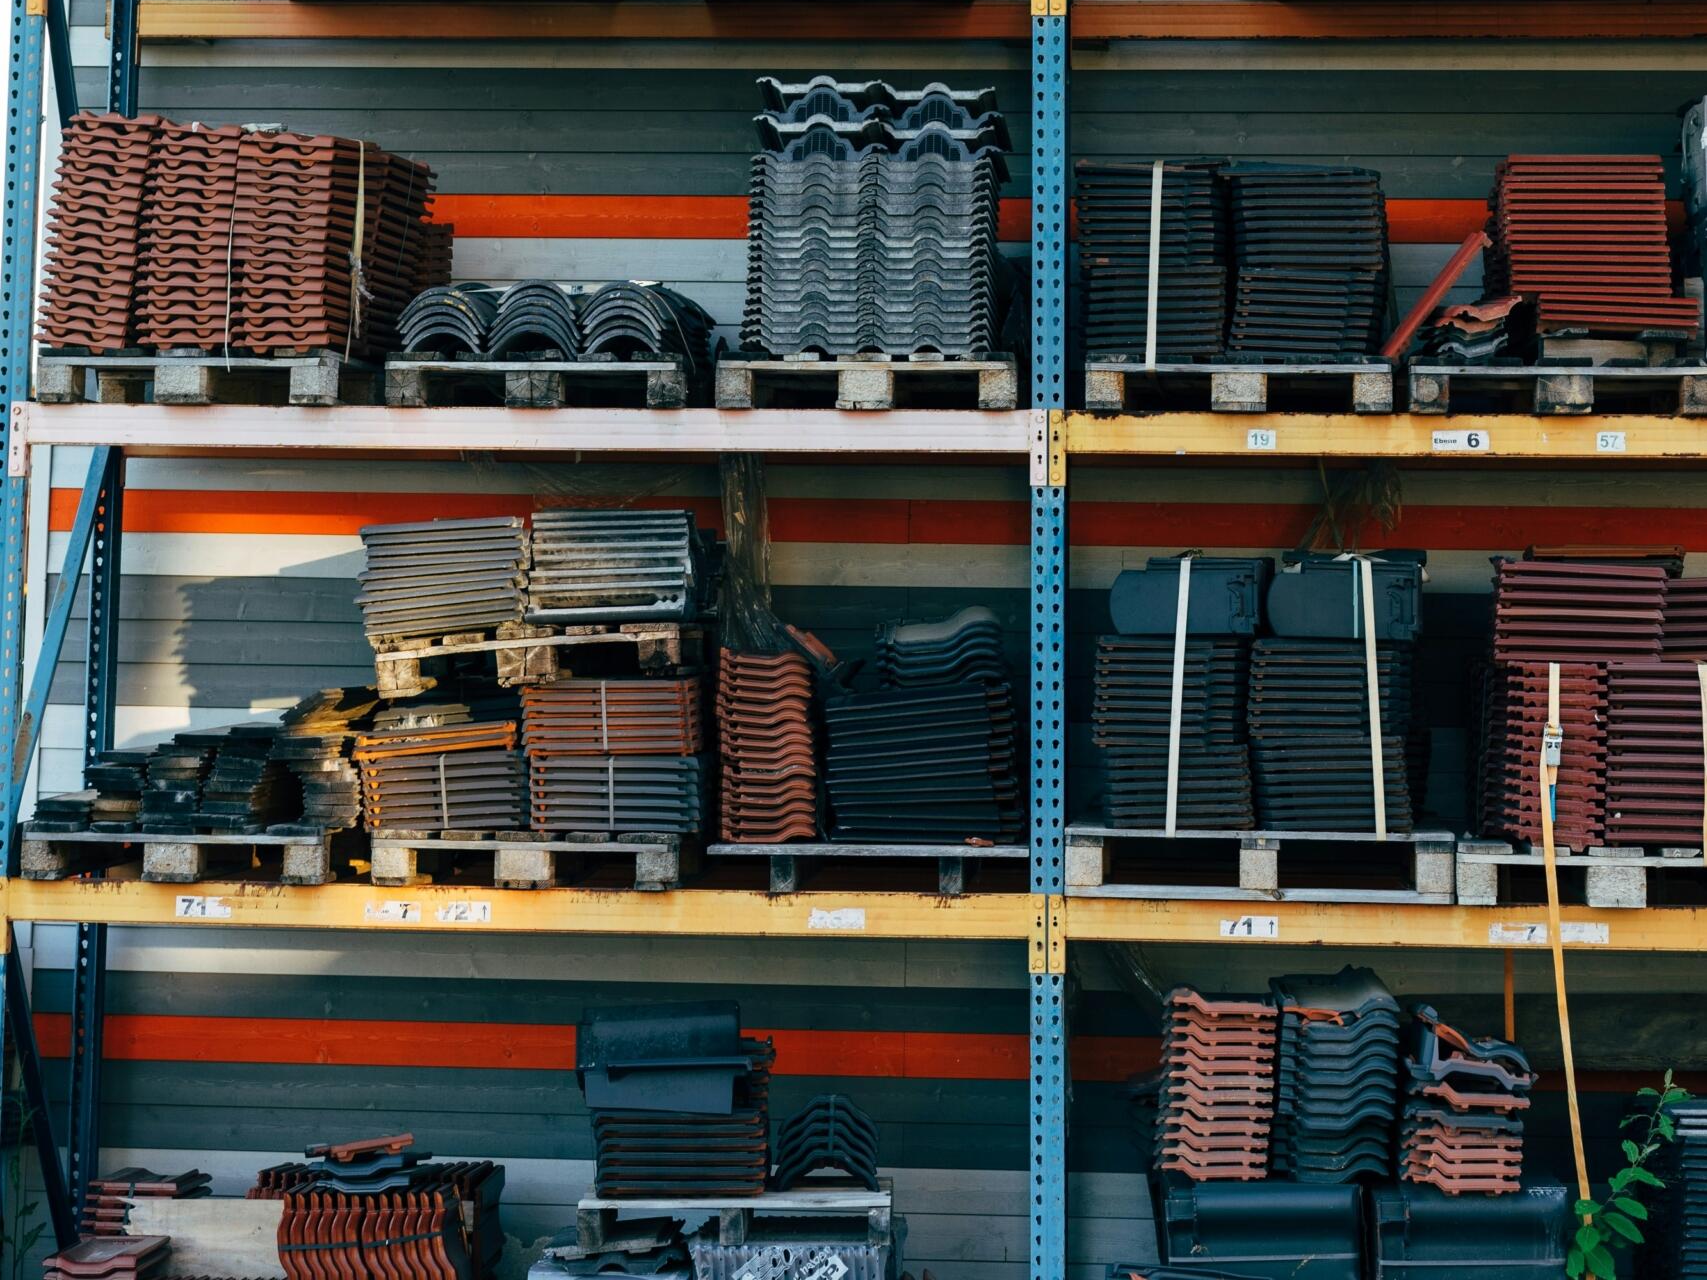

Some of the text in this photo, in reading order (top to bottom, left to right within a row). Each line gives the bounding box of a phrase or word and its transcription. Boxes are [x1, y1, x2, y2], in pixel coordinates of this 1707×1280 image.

[1251, 432, 1270, 446] 19
[1467, 432, 1480, 448] 6
[1600, 434, 1619, 448] 57
[181, 898, 206, 916] 71
